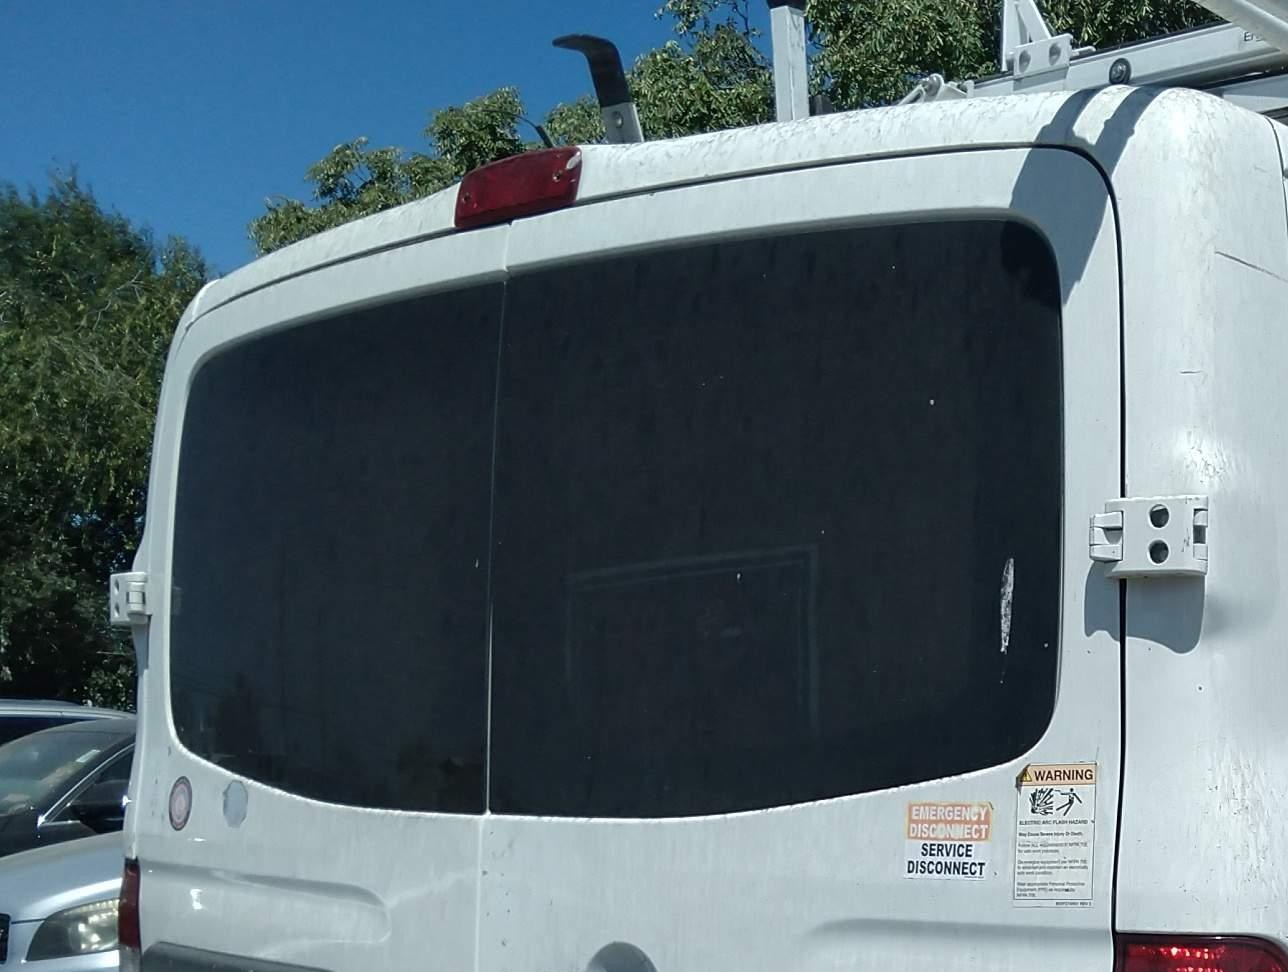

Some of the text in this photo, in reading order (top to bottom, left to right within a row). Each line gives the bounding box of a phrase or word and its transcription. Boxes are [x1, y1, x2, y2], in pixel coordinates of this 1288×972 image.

[1034, 769, 1094, 782] WARNING
[911, 805, 988, 821] EMERGENCY
[921, 843, 974, 858] SERVICE
[907, 860, 986, 876] DISCONNECT
